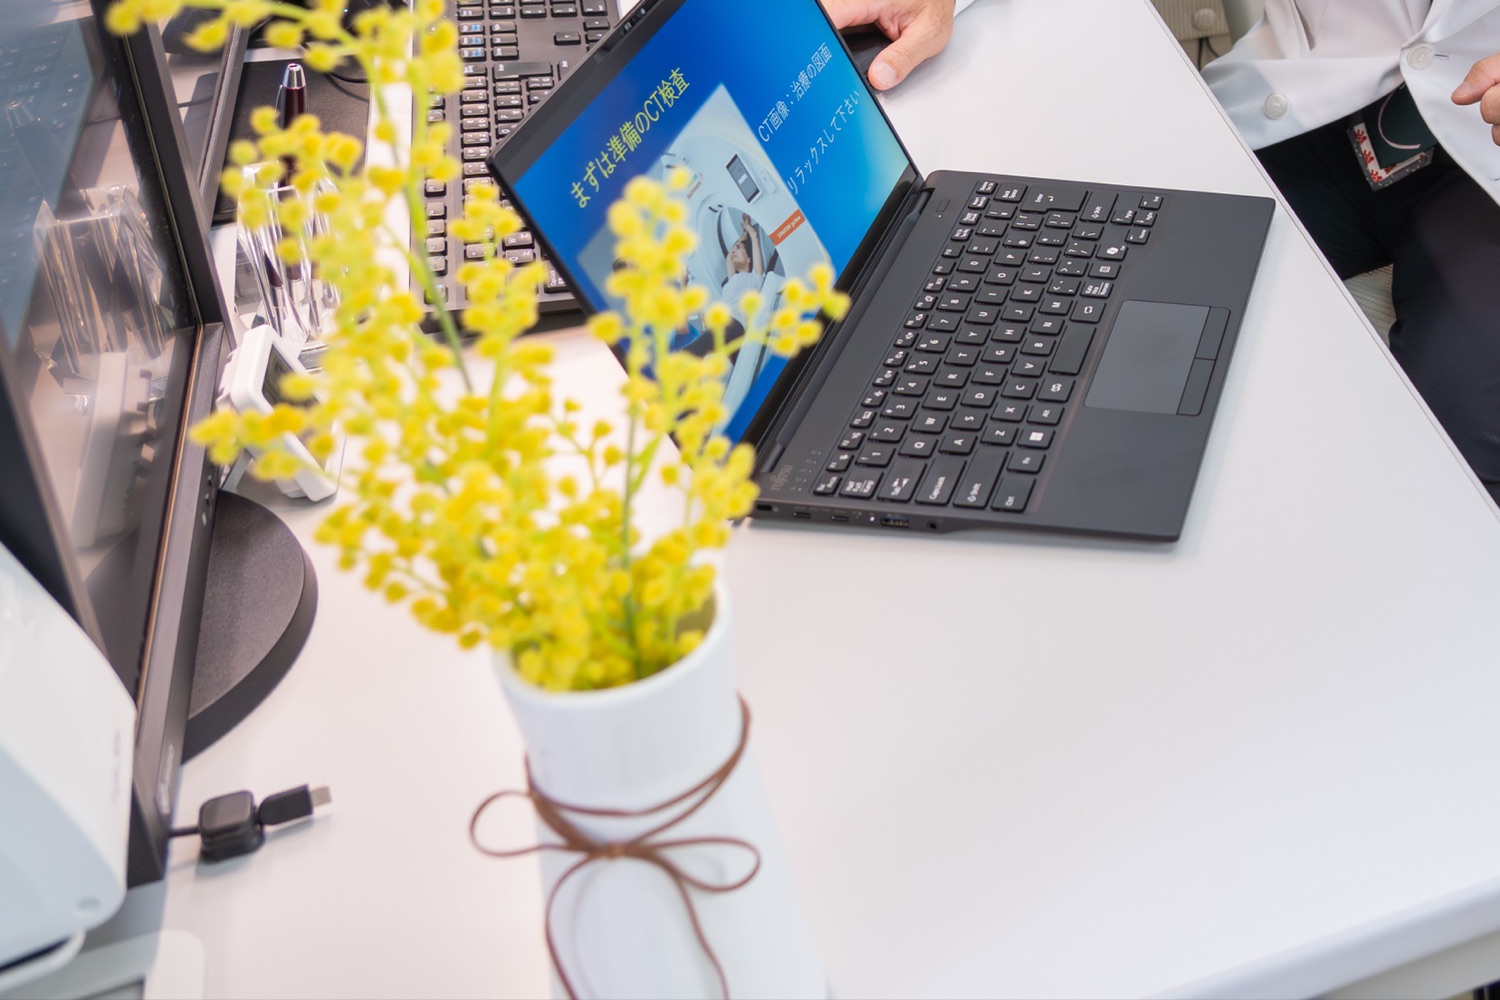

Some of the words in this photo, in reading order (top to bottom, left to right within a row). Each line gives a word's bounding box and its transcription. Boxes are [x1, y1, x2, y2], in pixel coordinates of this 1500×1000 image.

[571, 67, 690, 208] まずは準備のCT検査
[787, 90, 860, 194] リラックスして下さい
